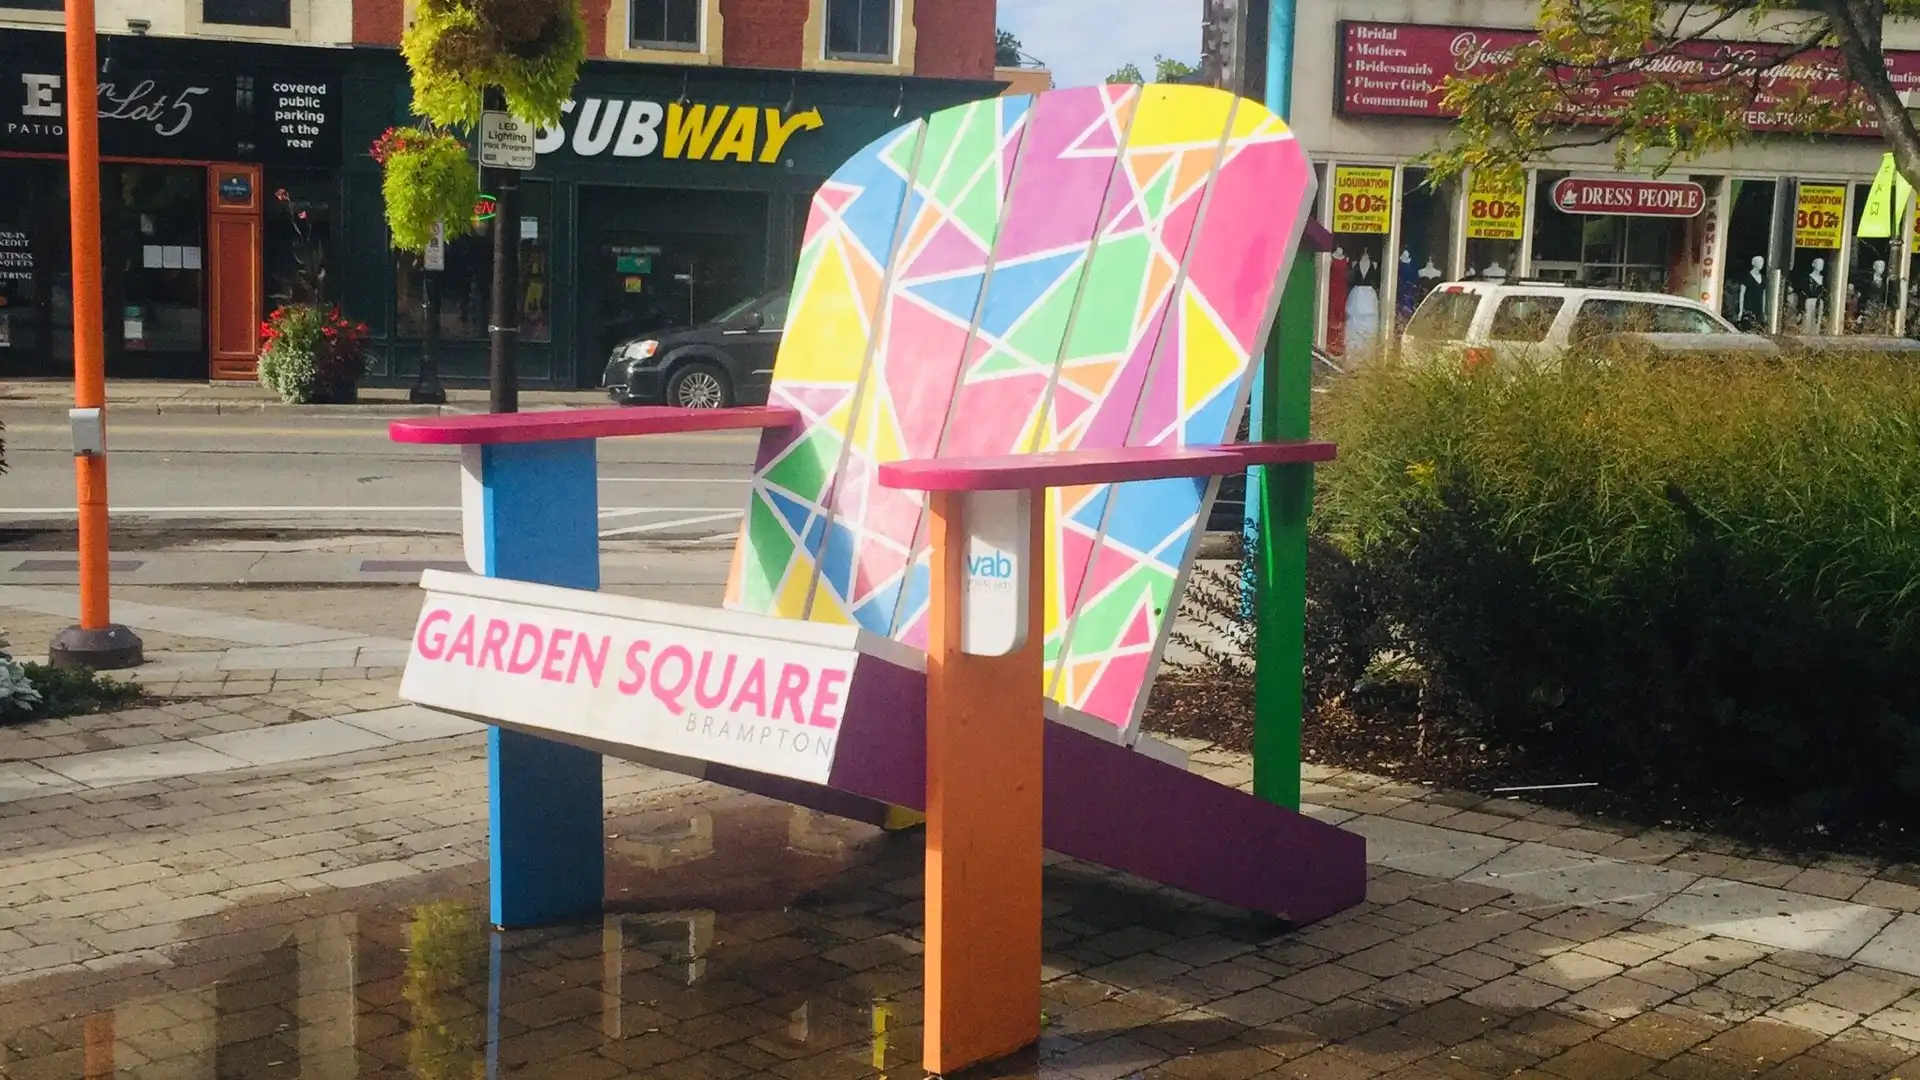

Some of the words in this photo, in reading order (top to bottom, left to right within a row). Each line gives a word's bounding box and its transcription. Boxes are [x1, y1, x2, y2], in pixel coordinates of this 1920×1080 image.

[1357, 27, 1397, 40] Bridal
[1356, 42, 1407, 57] Mothers
[1355, 60, 1433, 75] Bridesmaids
[272, 82, 326, 95] covered
[1354, 76, 1398, 90] Flower
[1400, 79, 1432, 92] Girls
[279, 96, 321, 108] public
[1353, 93, 1428, 108] Communion
[155, 86, 210, 136] 5
[275, 110, 325, 124] parking
[8, 122, 63, 136] PATIO
[280, 124, 294, 134] at
[297, 124, 319, 135] the
[498, 122, 518, 131] LED
[535, 97, 824, 163] SUBWAY
[488, 130, 527, 143] Lighting
[286, 139, 314, 149] rear
[501, 143, 532, 152] Program
[1338, 177, 1389, 189] LIQUIDATION
[1581, 186, 1633, 206] DRESS
[1637, 188, 1699, 209] PEOPLE
[1370, 204, 1388, 213] OFF
[1504, 210, 1521, 219] OFF
[1823, 219, 1839, 229] OFF
[966, 549, 1012, 579] vab
[416, 608, 612, 690] GARDEN
[617, 638, 848, 731] SQUARE
[685, 711, 834, 759] BRAMPTON
